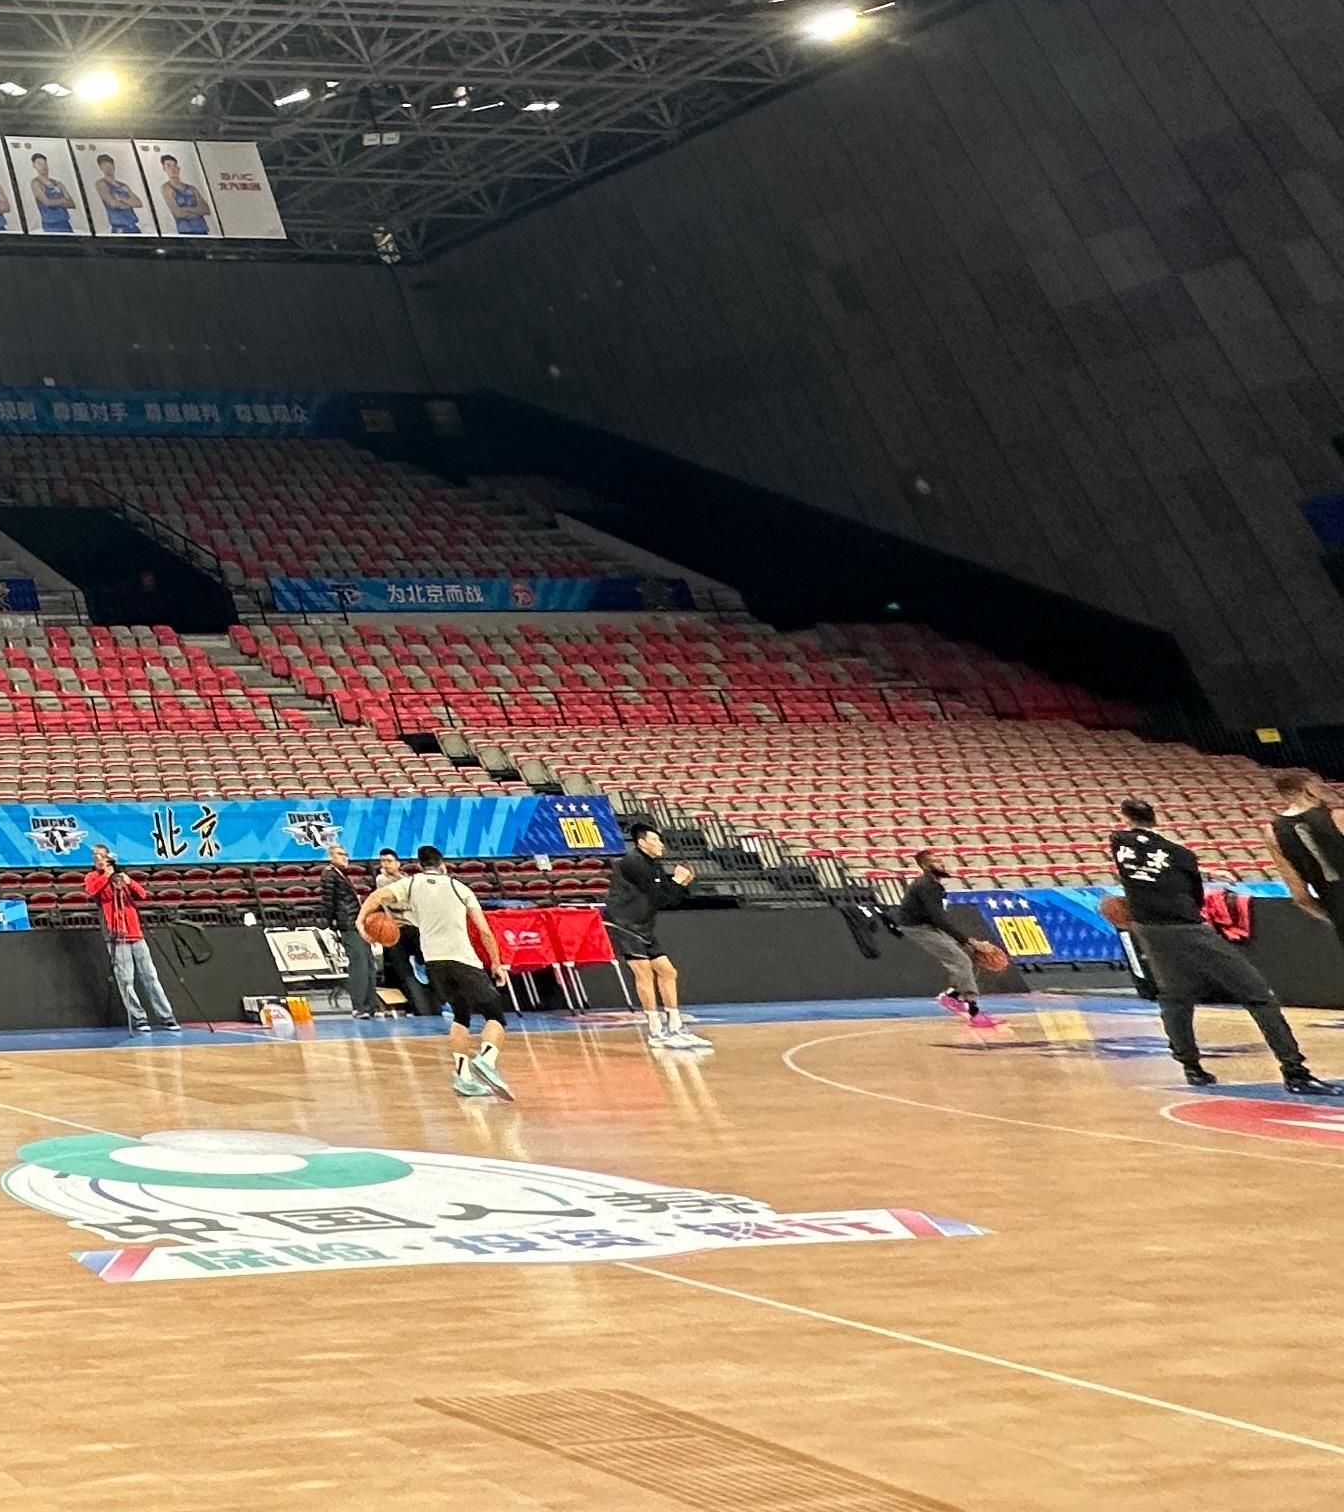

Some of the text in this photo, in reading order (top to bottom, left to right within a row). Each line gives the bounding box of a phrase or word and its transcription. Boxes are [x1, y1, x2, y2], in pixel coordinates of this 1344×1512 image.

[387, 584, 484, 605] 为北京而战
[31, 816, 77, 831] DUCKS
[151, 804, 221, 860] 北京
[81, 1190, 762, 1244] 中国人寿
